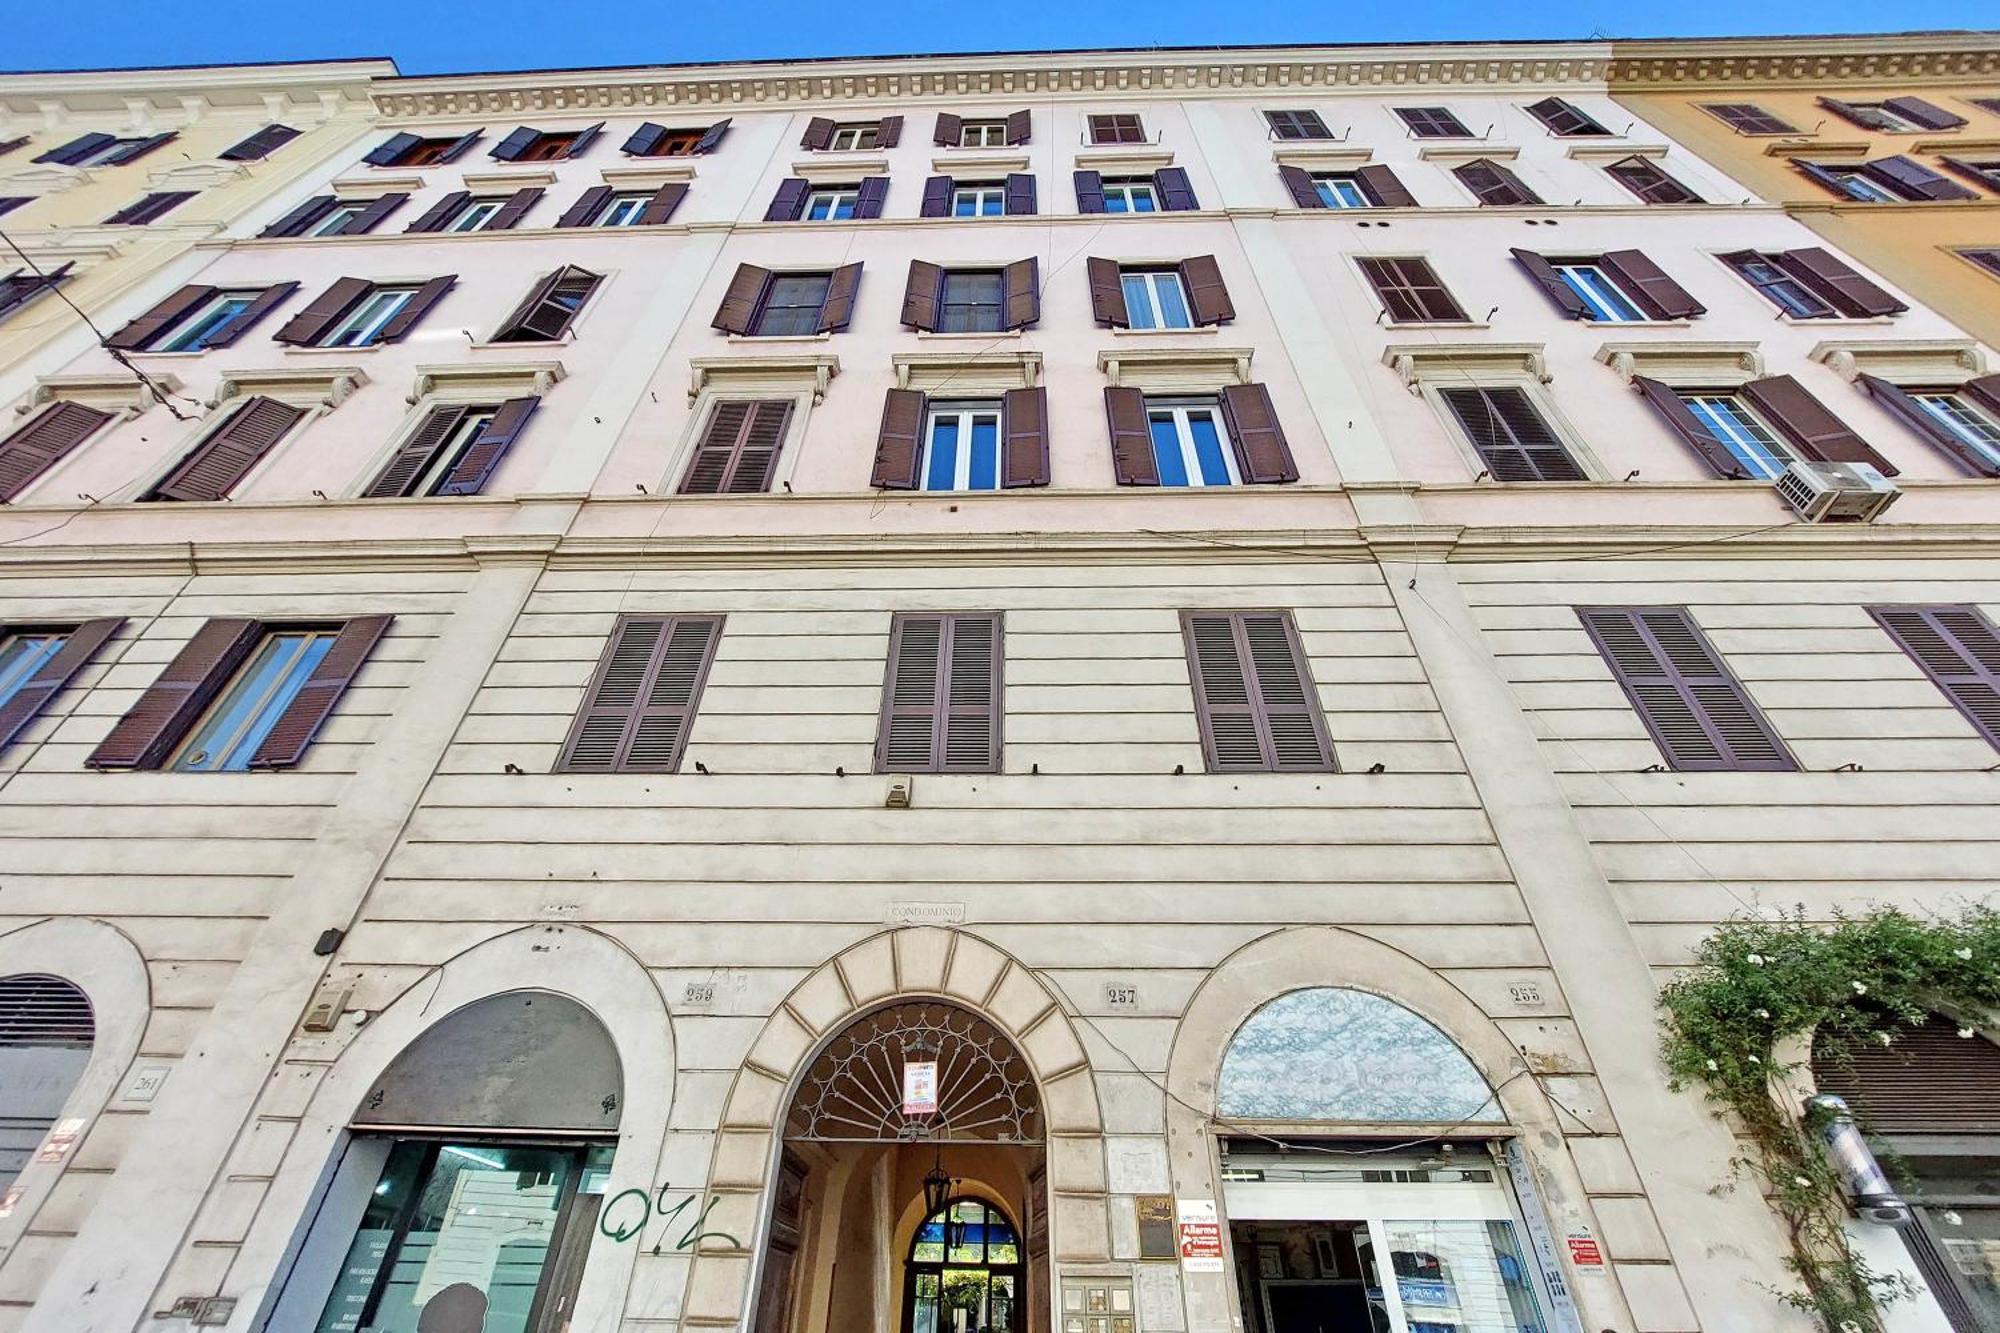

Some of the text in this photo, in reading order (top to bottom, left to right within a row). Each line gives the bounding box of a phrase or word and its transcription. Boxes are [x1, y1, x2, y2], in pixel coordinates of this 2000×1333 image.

[891, 906, 961, 917] CONDOMINIO
[687, 988, 713, 1002] 259
[1108, 989, 1136, 1003] 257
[1510, 987, 1540, 1002] 255
[134, 1078, 159, 1090] 261
[1183, 1224, 1218, 1235] Allarme
